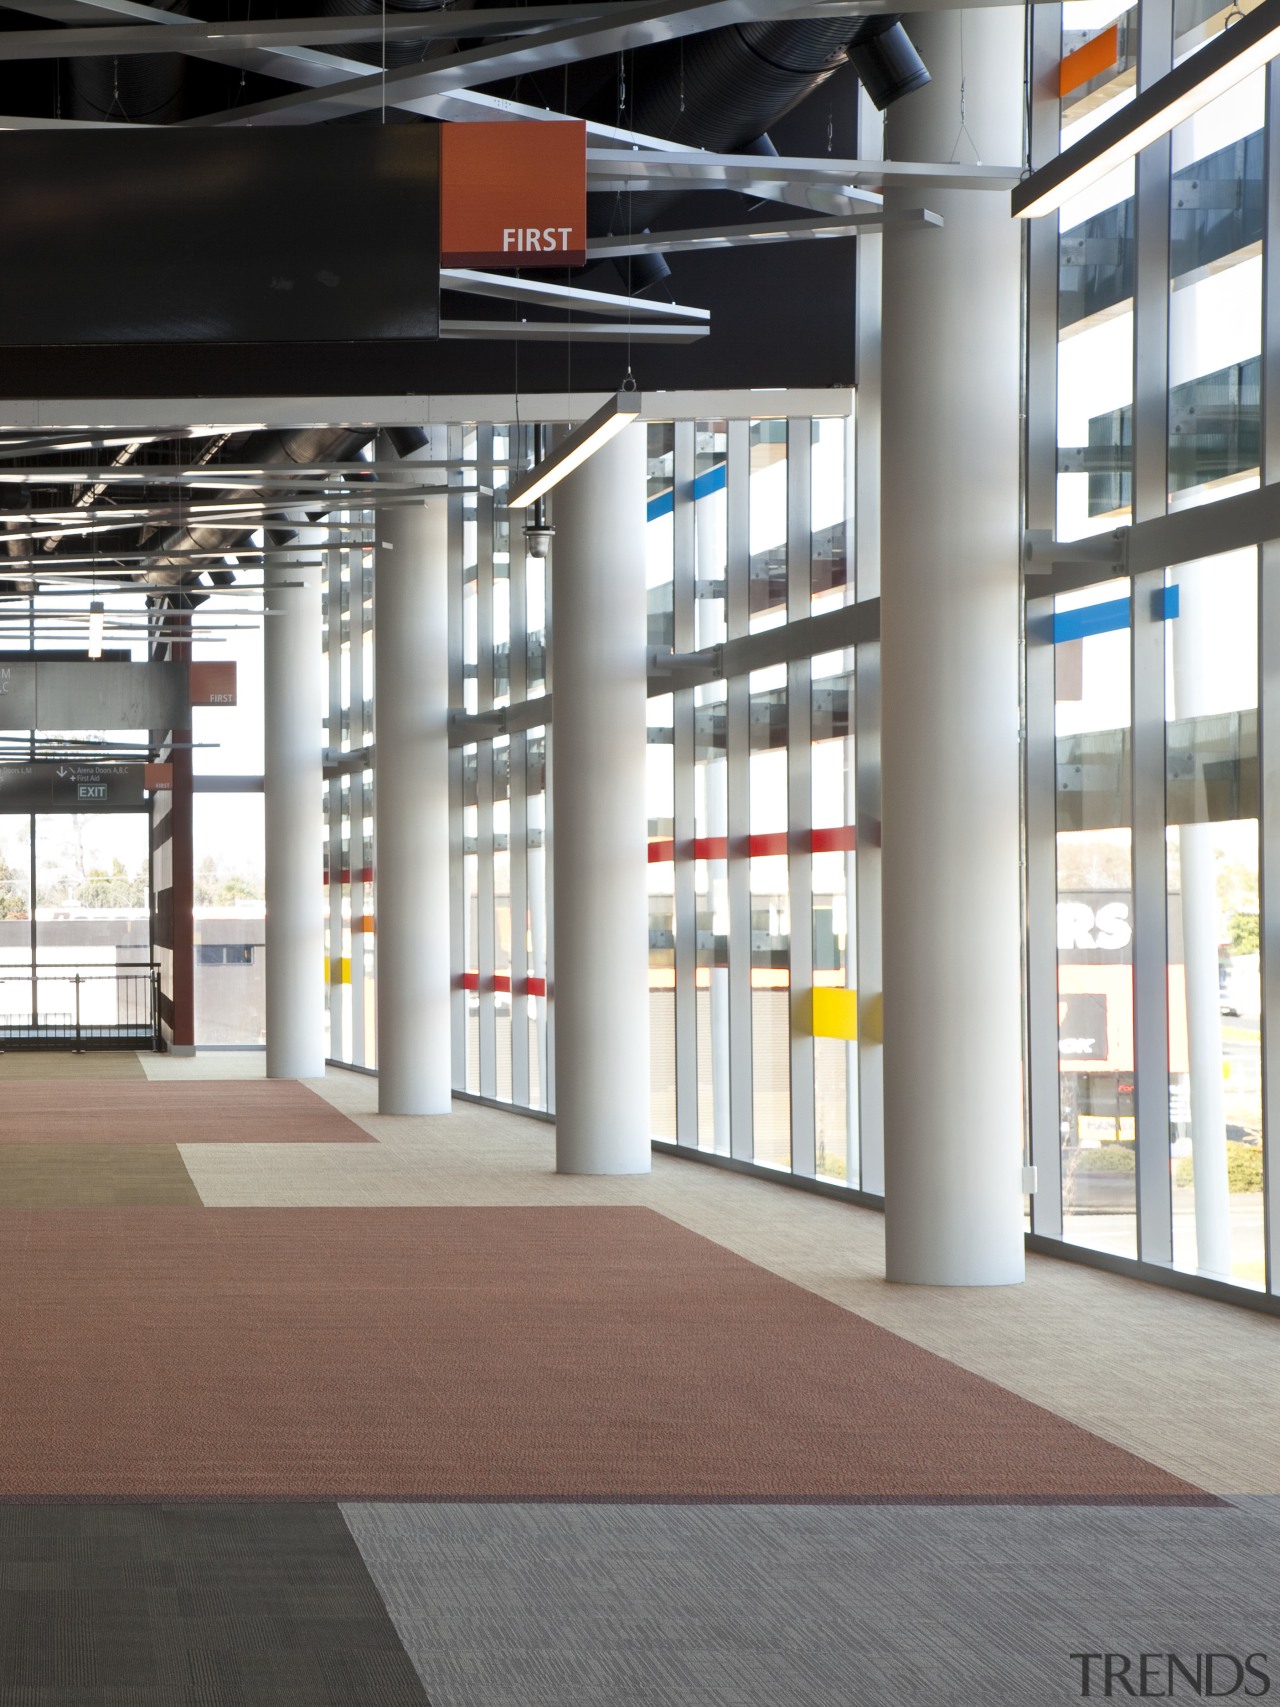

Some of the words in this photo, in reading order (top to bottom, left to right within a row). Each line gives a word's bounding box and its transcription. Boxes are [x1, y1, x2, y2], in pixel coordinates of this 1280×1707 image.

[503, 227, 573, 252] FIRST
[210, 694, 233, 703] FIRST
[3, 766, 20, 774] Doors
[76, 766, 94, 774] Arena
[95, 766, 111, 774] Doors
[90, 774, 100, 782] Aid
[79, 786, 106, 798] EXIT
